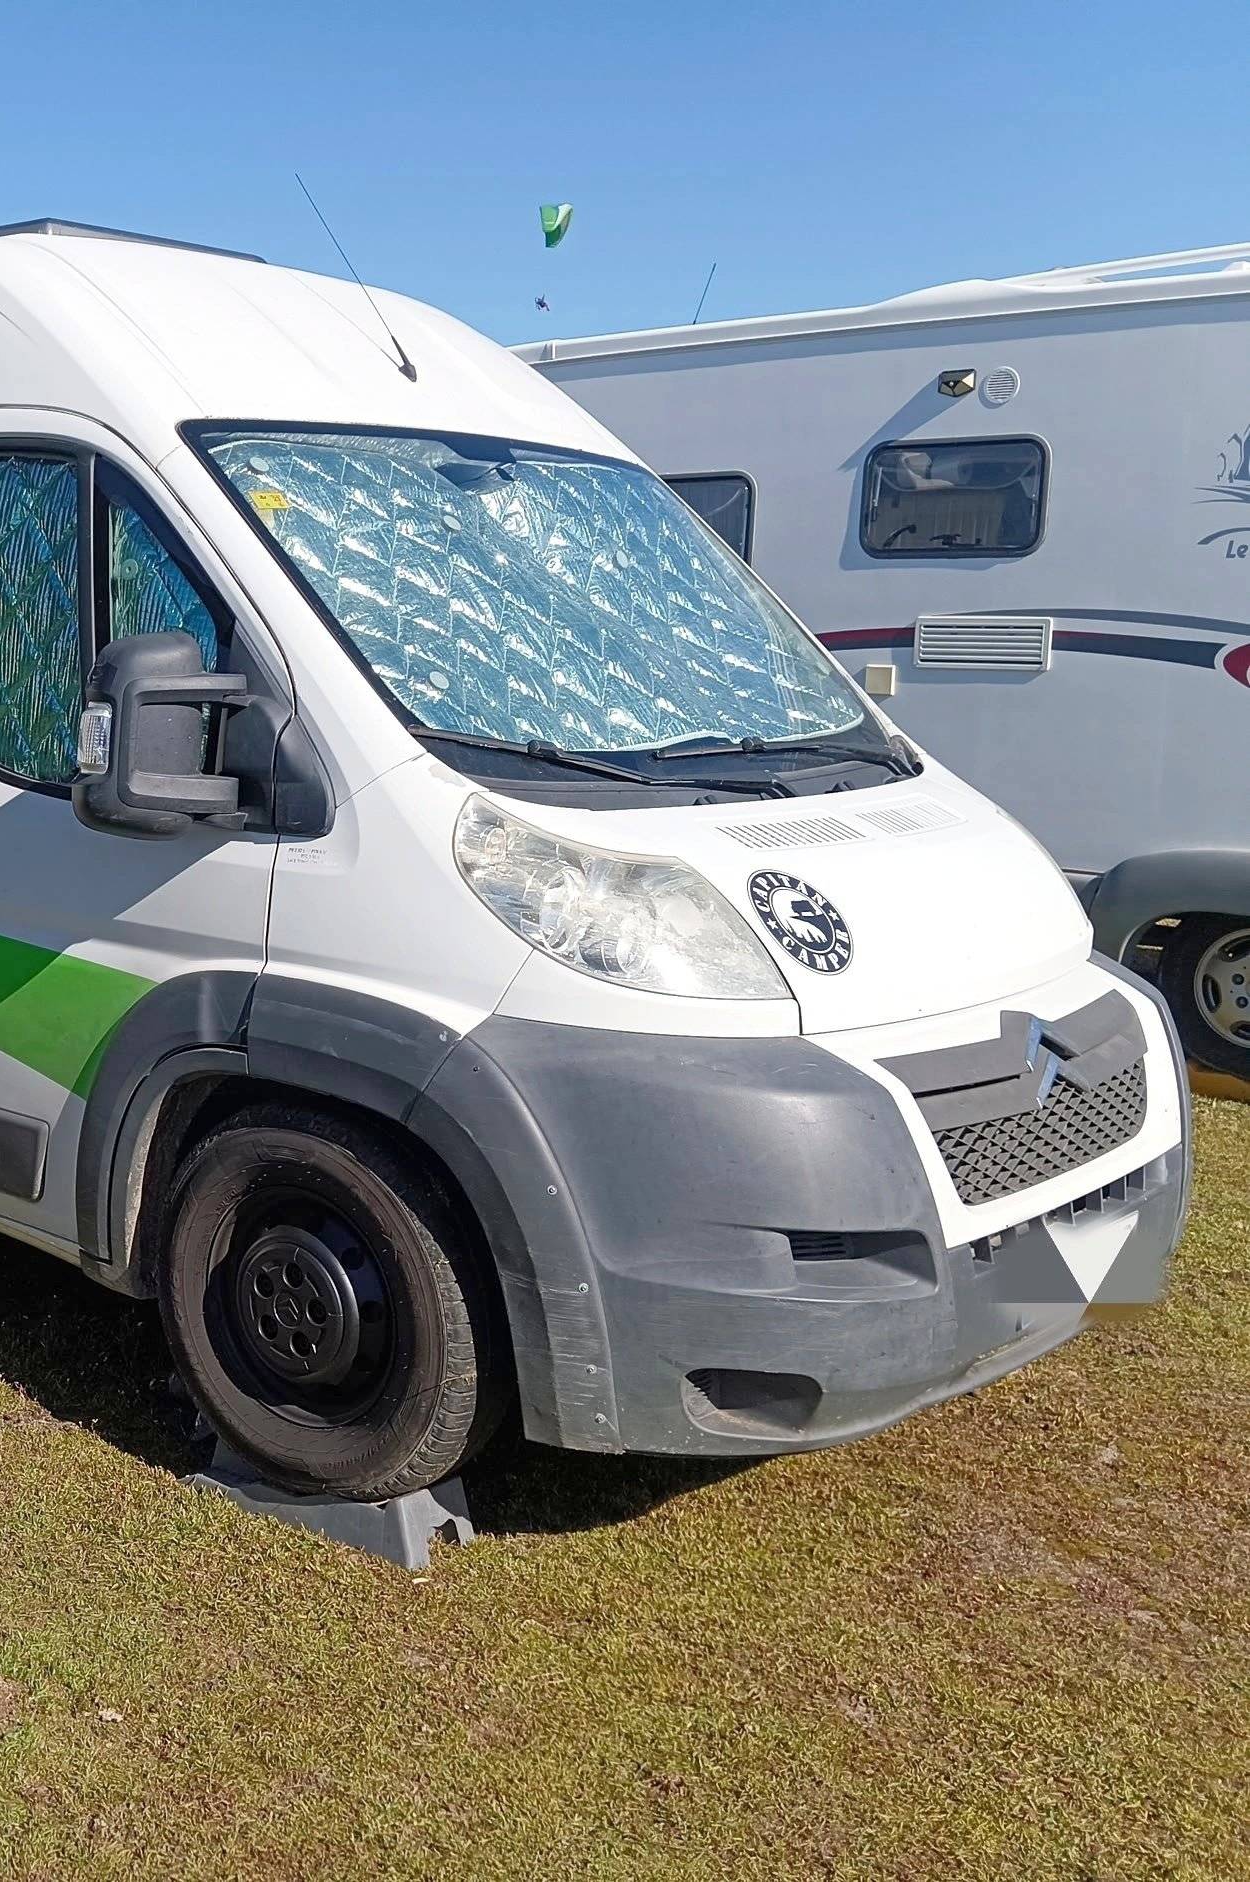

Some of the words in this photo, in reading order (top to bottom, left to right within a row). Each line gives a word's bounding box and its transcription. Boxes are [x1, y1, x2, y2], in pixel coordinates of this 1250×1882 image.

[1226, 540, 1248, 559] Le
[753, 873, 827, 913] CAPITAN
[781, 928, 851, 972] CAMPER
